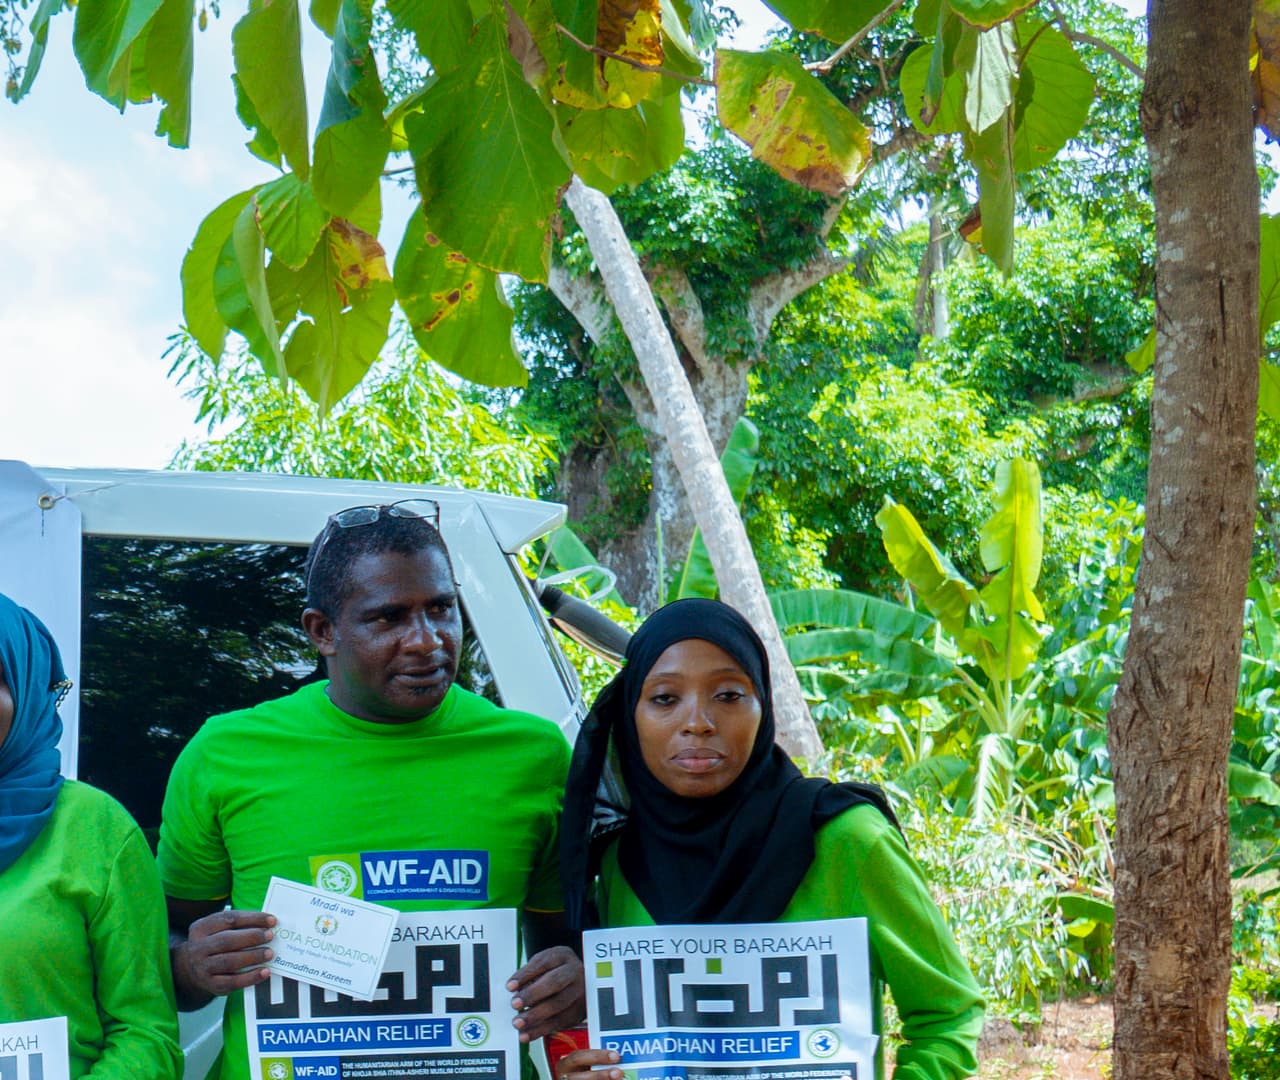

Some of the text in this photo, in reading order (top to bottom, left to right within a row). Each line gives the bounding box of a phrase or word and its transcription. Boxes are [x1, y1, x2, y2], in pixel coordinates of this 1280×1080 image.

[364, 858, 482, 886] WF-AID
[310, 897, 355, 916] Mradi wa
[274, 928, 302, 944] YOTA
[306, 936, 378, 965] FOUNDATION
[595, 935, 832, 958] SHARE YOUR BARAKAH
[274, 956, 319, 976] Ramadhan
[320, 970, 352, 986] Kareem
[262, 1024, 444, 1046] RAMADHAN RELIEF
[606, 1036, 793, 1056] RAMADHAN RELIEF
[296, 1066, 337, 1076] WF-AID
